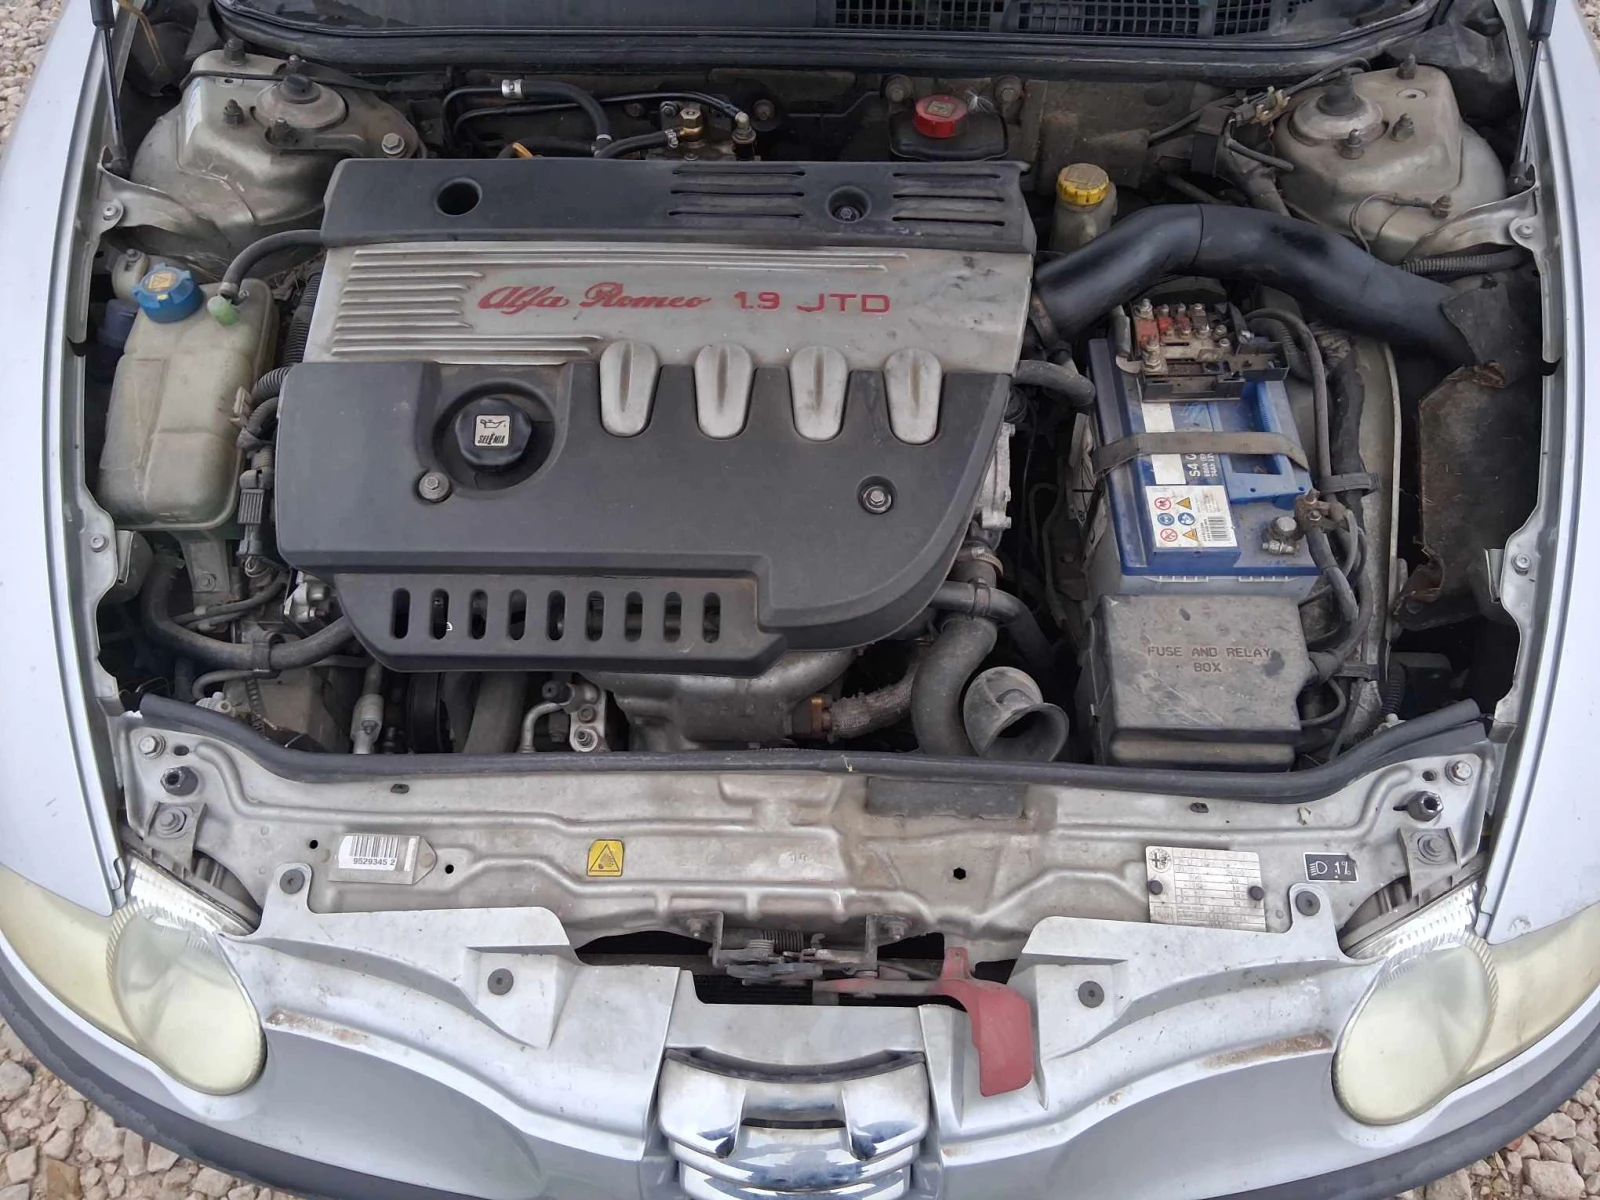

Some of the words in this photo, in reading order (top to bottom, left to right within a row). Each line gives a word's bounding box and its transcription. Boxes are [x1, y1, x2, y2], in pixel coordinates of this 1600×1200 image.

[478, 286, 569, 315] Alfa
[579, 282, 711, 308] Romeo
[734, 291, 780, 309] 1.9
[797, 293, 890, 312] JTD
[1187, 463, 1201, 478] S4
[1147, 646, 1183, 657] FUSE
[1191, 647, 1218, 658] AND
[1226, 647, 1271, 658] RELAY
[1193, 662, 1222, 673] BOX
[353, 857, 388, 866] 9529345
